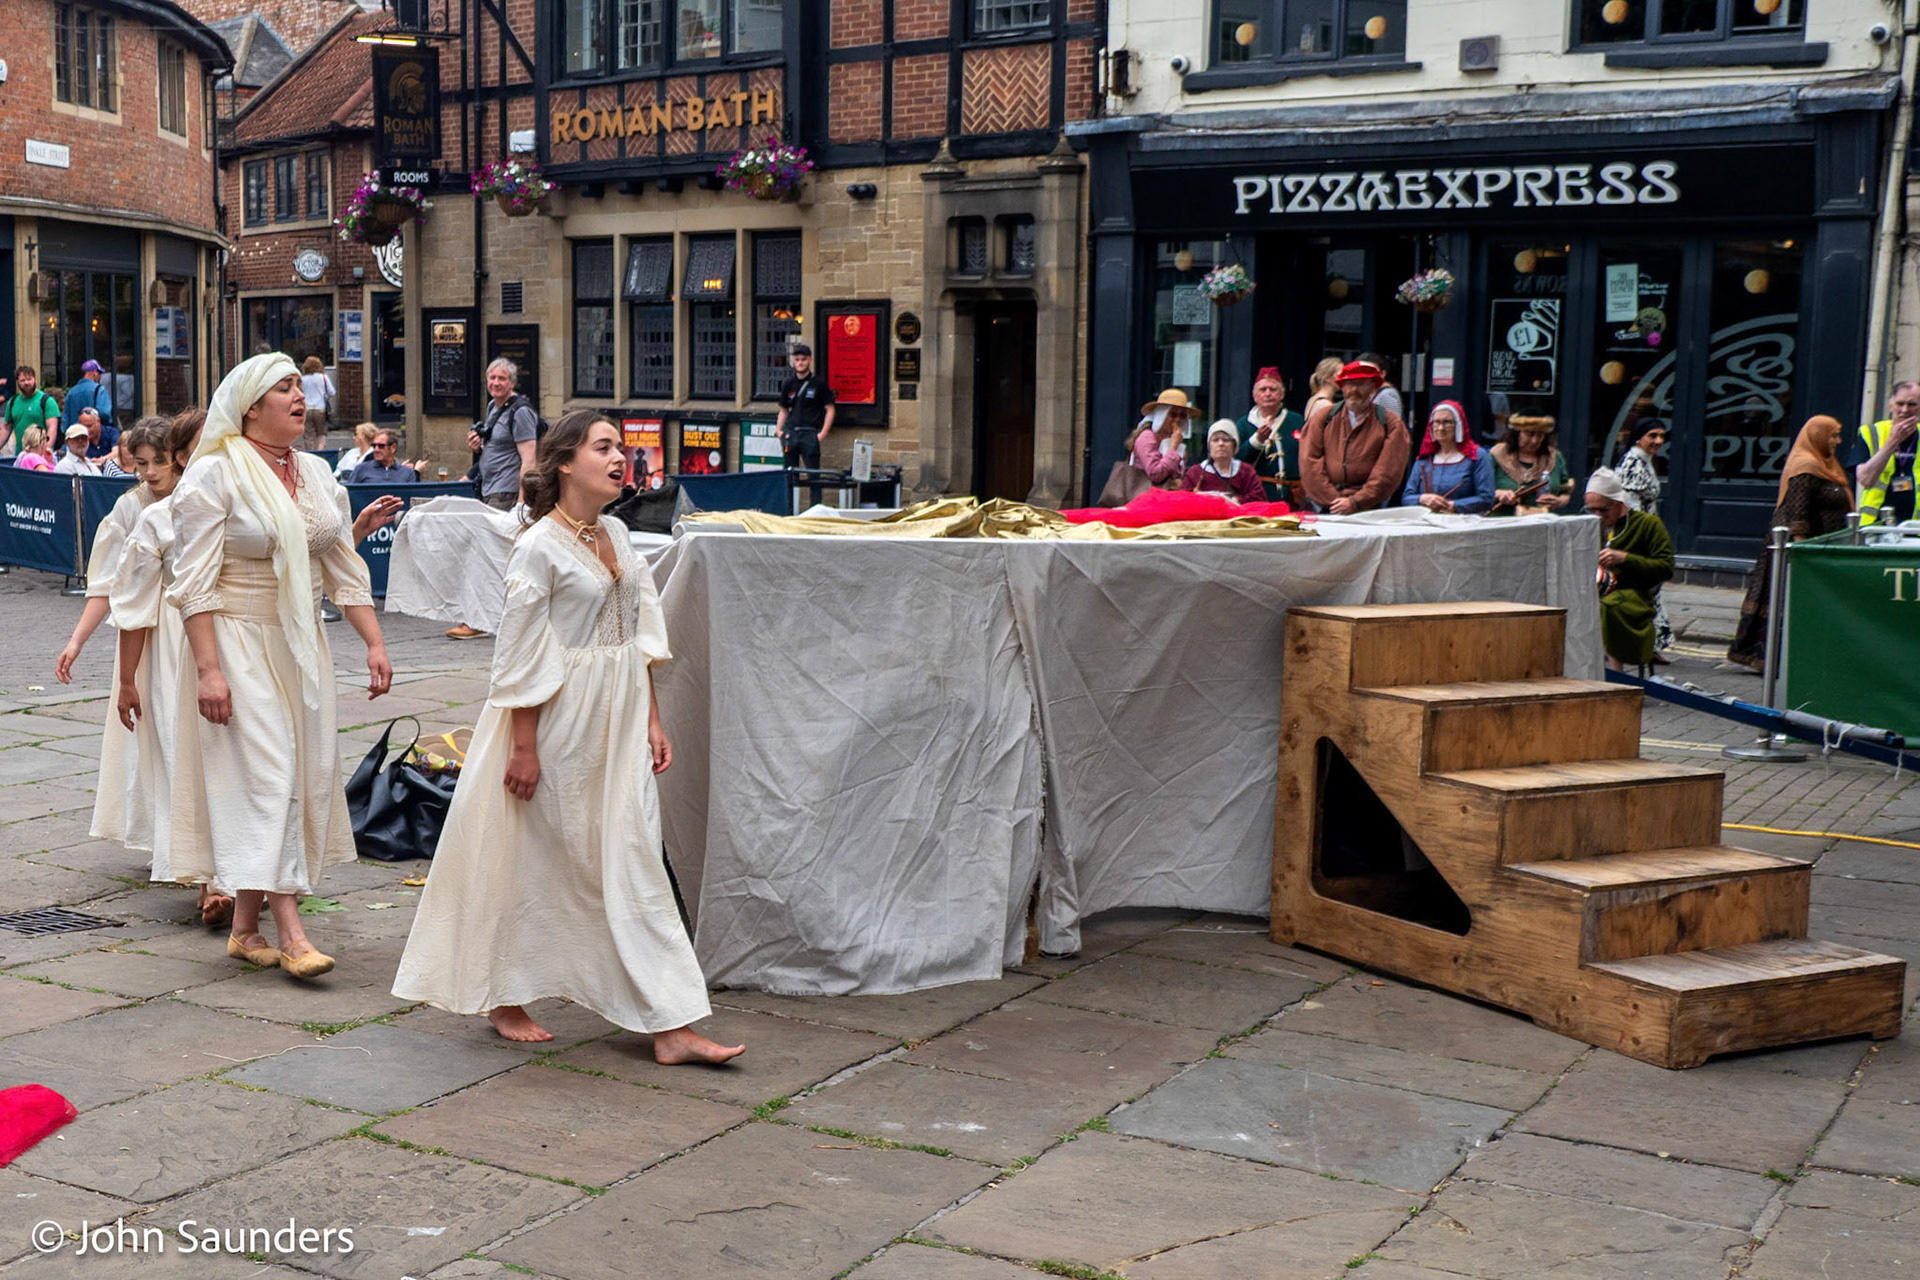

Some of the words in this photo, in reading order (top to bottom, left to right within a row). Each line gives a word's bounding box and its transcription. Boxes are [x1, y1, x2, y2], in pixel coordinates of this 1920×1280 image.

[552, 100, 673, 144] ROMAN
[686, 89, 774, 131] BATH
[383, 115, 433, 135] ROMAN
[393, 133, 426, 146] BATH
[393, 172, 429, 183] ROOMS
[439, 334, 458, 342] MUSIC
[1513, 326, 1533, 348] £1
[1493, 351, 1516, 361] REAL
[1493, 360, 1517, 370] MEAL
[625, 432, 638, 440] LIVE
[639, 432, 660, 440] MUSIC
[750, 423, 767, 436] NEXT
[684, 431, 702, 440] BUST
[704, 432, 720, 442] OUT
[5, 503, 33, 520] ROMAN
[34, 507, 55, 523] BATH
[1883, 567, 1920, 601] T
